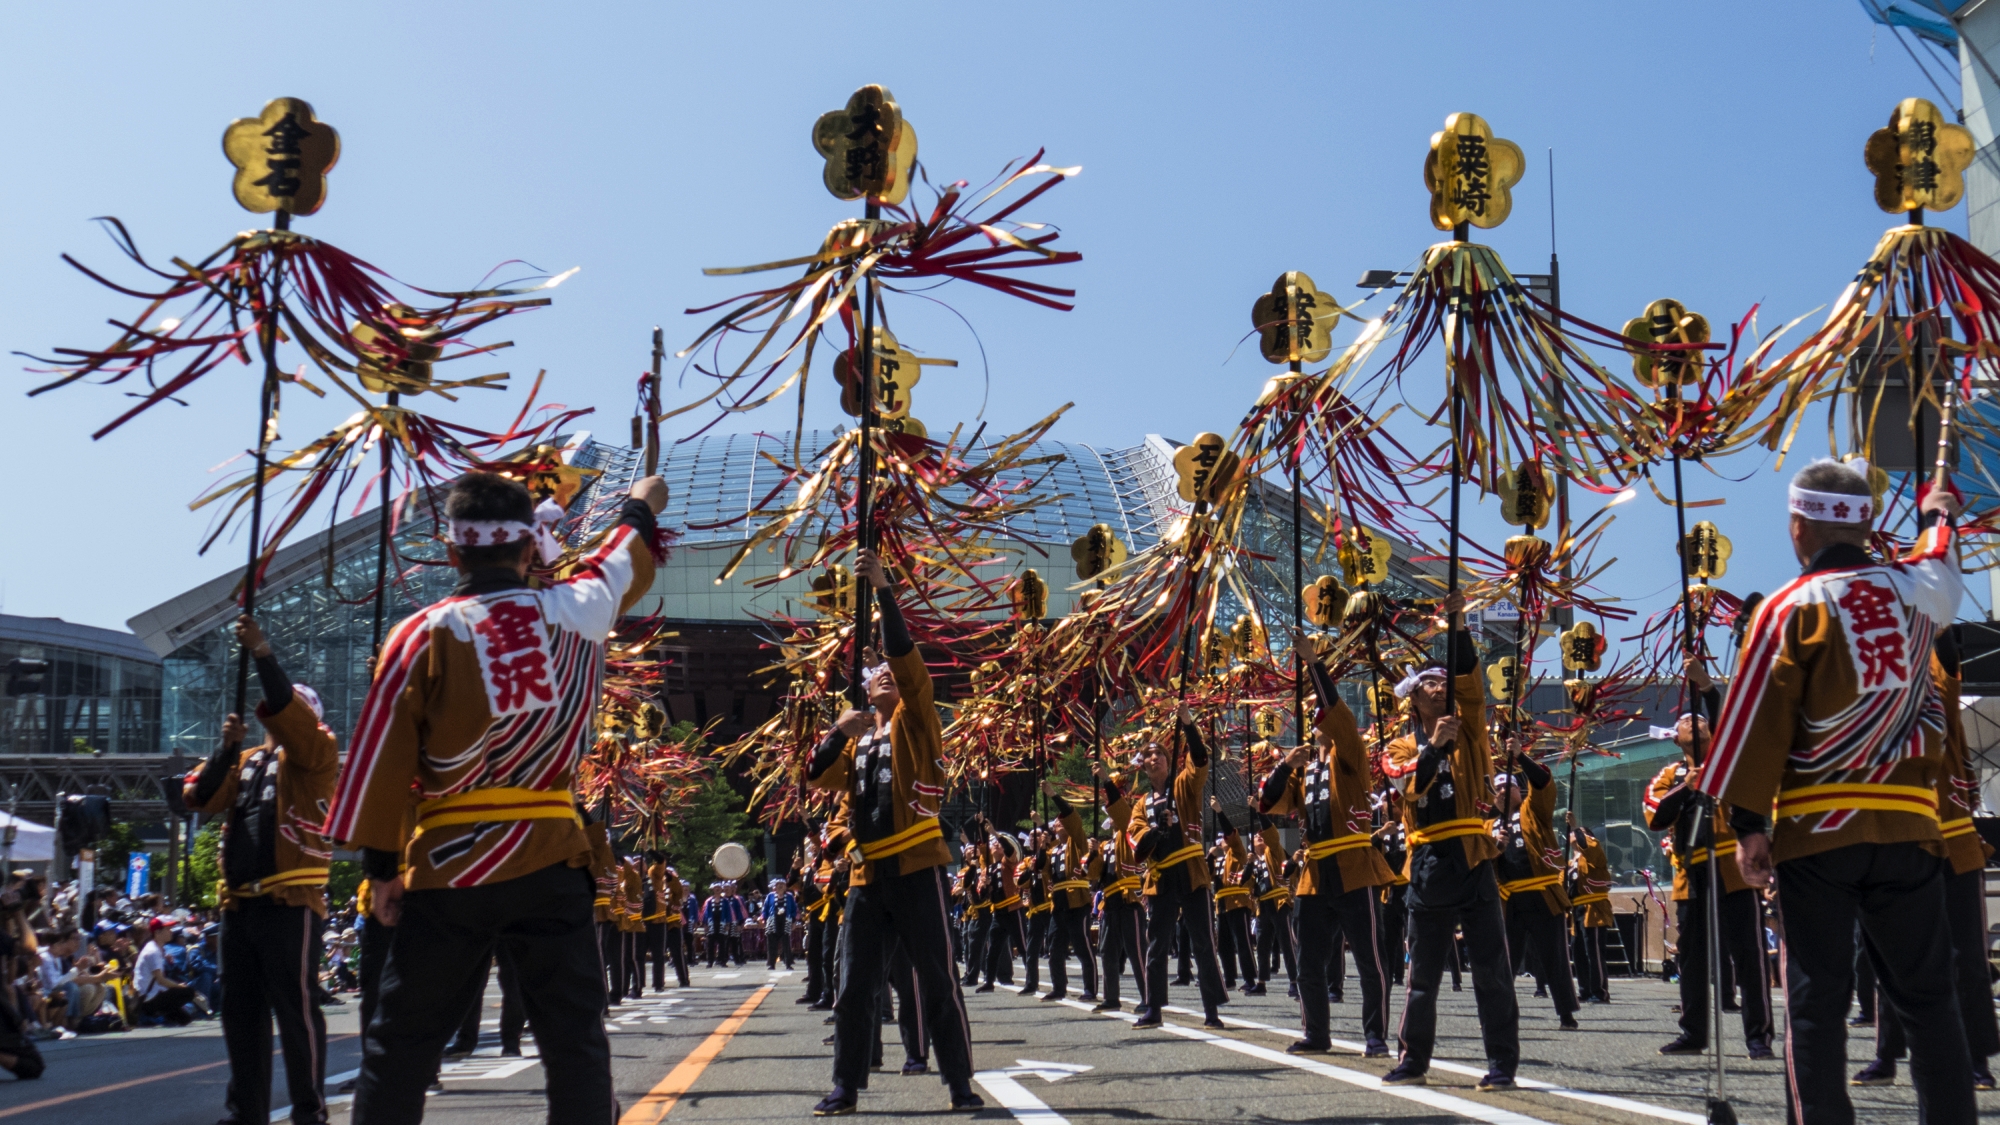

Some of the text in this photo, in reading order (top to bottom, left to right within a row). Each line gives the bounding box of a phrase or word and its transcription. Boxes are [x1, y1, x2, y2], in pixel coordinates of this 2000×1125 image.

[253, 112, 311, 198] 金石
[845, 104, 883, 182] 大野
[1453, 135, 1492, 219] 粟崎
[1272, 289, 1316, 350] 安原
[1316, 584, 1338, 621] 内川
[1841, 580, 1908, 688] 金沢
[476, 600, 553, 710] 金沢
[1570, 637, 1595, 665] 額
